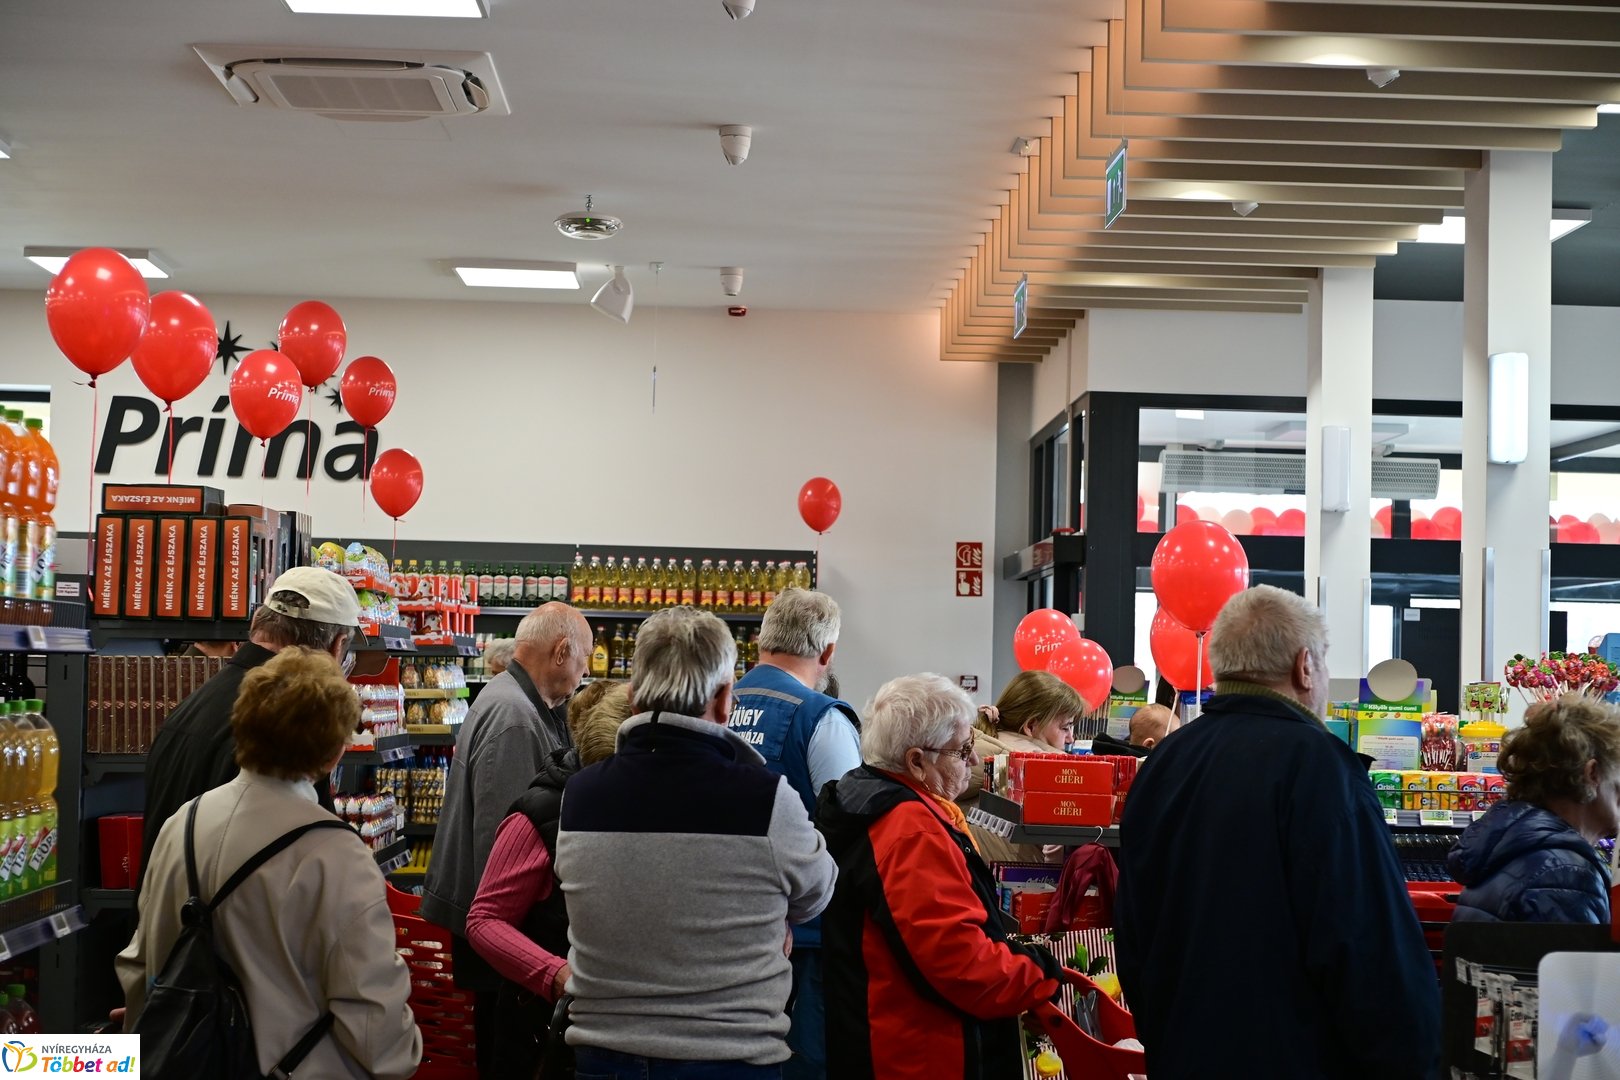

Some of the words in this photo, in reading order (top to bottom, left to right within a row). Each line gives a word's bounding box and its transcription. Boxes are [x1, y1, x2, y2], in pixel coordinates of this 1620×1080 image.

[94, 395, 380, 482] Príma
[111, 495, 151, 505] ÉJSZAKA
[152, 495, 165, 503] AZ
[166, 495, 195, 505] MIÉNK
[103, 523, 114, 565] ÉJSZAKA
[134, 524, 145, 566] ÉJSZAKA
[165, 525, 177, 566] ÉJSZAKA
[197, 525, 208, 566] ÉJSZAKA
[229, 525, 240, 566] ÉJSZAKA
[104, 565, 112, 579] AZ
[135, 566, 143, 580] AZ
[166, 566, 175, 580] AZ
[198, 566, 206, 581] AZ
[231, 566, 239, 581] AZ
[102, 579, 111, 609] MIÉNK
[133, 580, 142, 610] MIÉNK
[164, 580, 174, 610] MIÉNK
[196, 580, 205, 611] MIÉNK
[229, 581, 239, 611] MIÉNK
